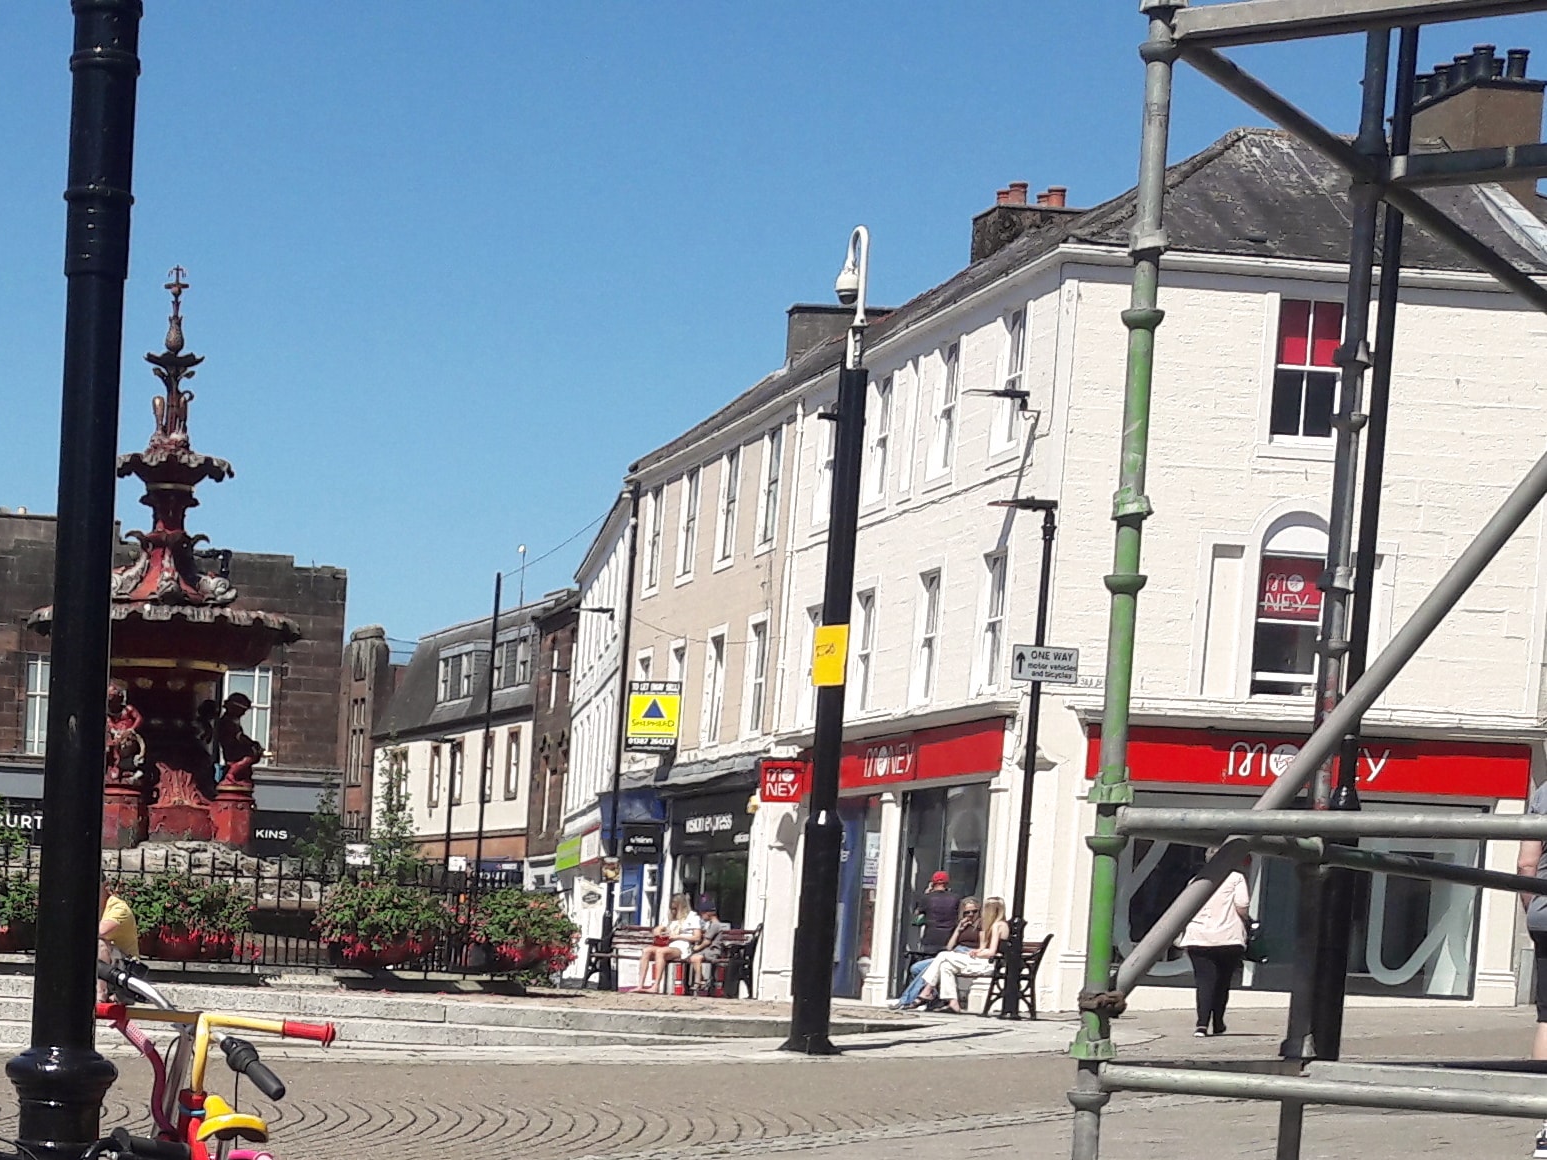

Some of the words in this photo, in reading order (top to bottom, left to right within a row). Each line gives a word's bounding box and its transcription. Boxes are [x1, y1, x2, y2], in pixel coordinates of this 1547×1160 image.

[1031, 650, 1051, 661] ONE
[1053, 652, 1074, 662] WAY
[1027, 662, 1048, 670] motor
[1049, 663, 1077, 672] vehicles
[1044, 671, 1072, 680] bicycles
[1227, 741, 1391, 782] MOY
[254, 828, 289, 841] KINS
